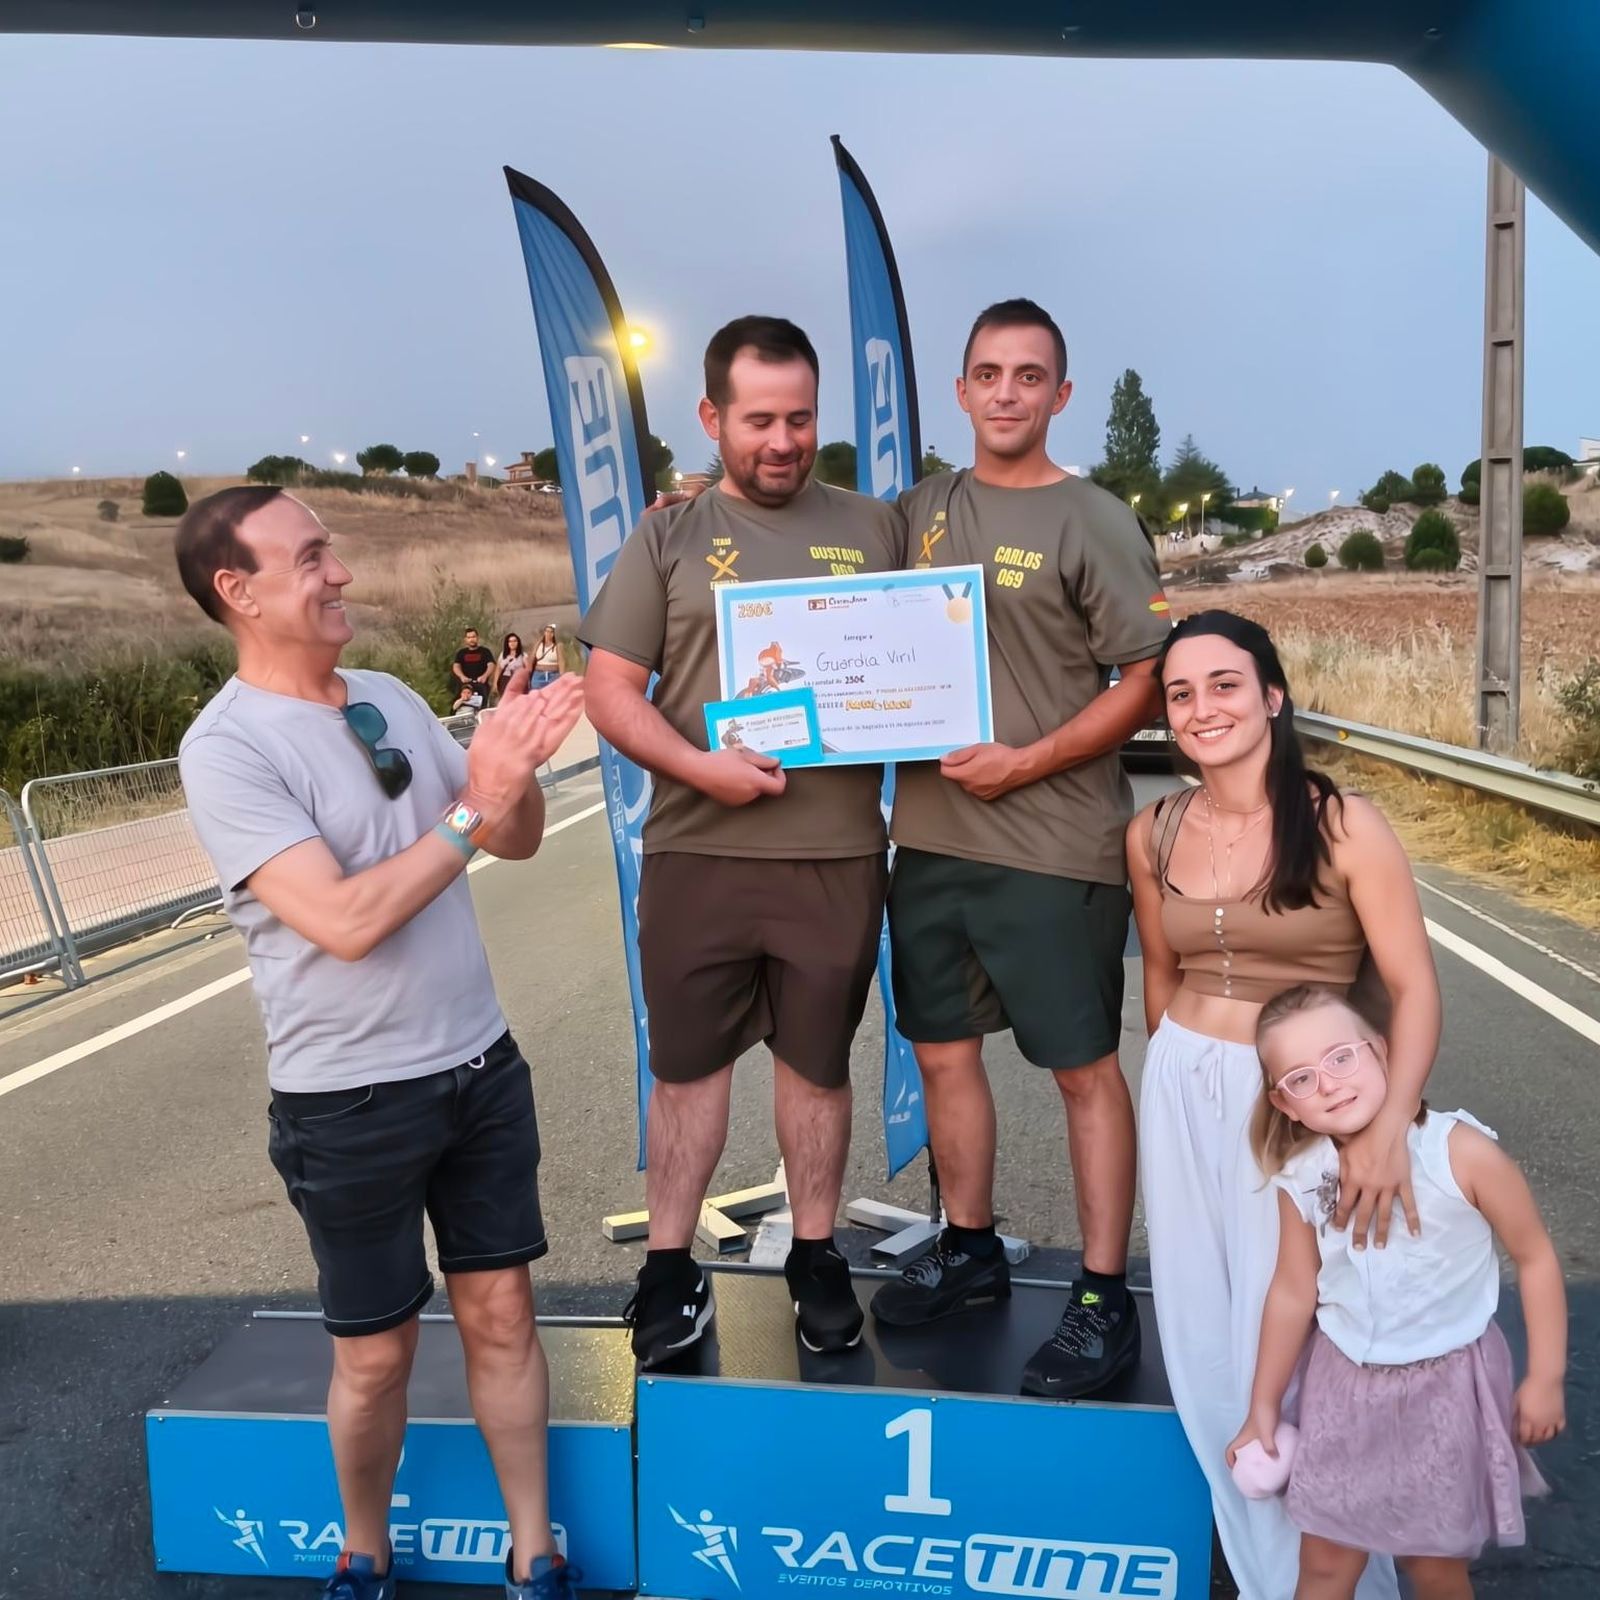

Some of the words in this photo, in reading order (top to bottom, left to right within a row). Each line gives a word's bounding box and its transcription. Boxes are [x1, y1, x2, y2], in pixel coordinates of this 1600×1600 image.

[994, 546, 1043, 570] CARLOS
[996, 568, 1024, 589] 069
[816, 652, 880, 672] Guardia
[886, 645, 916, 664] Viril
[884, 1408, 952, 1517] 1
[777, 1573, 847, 1587] EVENTOS
[853, 1578, 953, 1595] DEPORTIVOS
